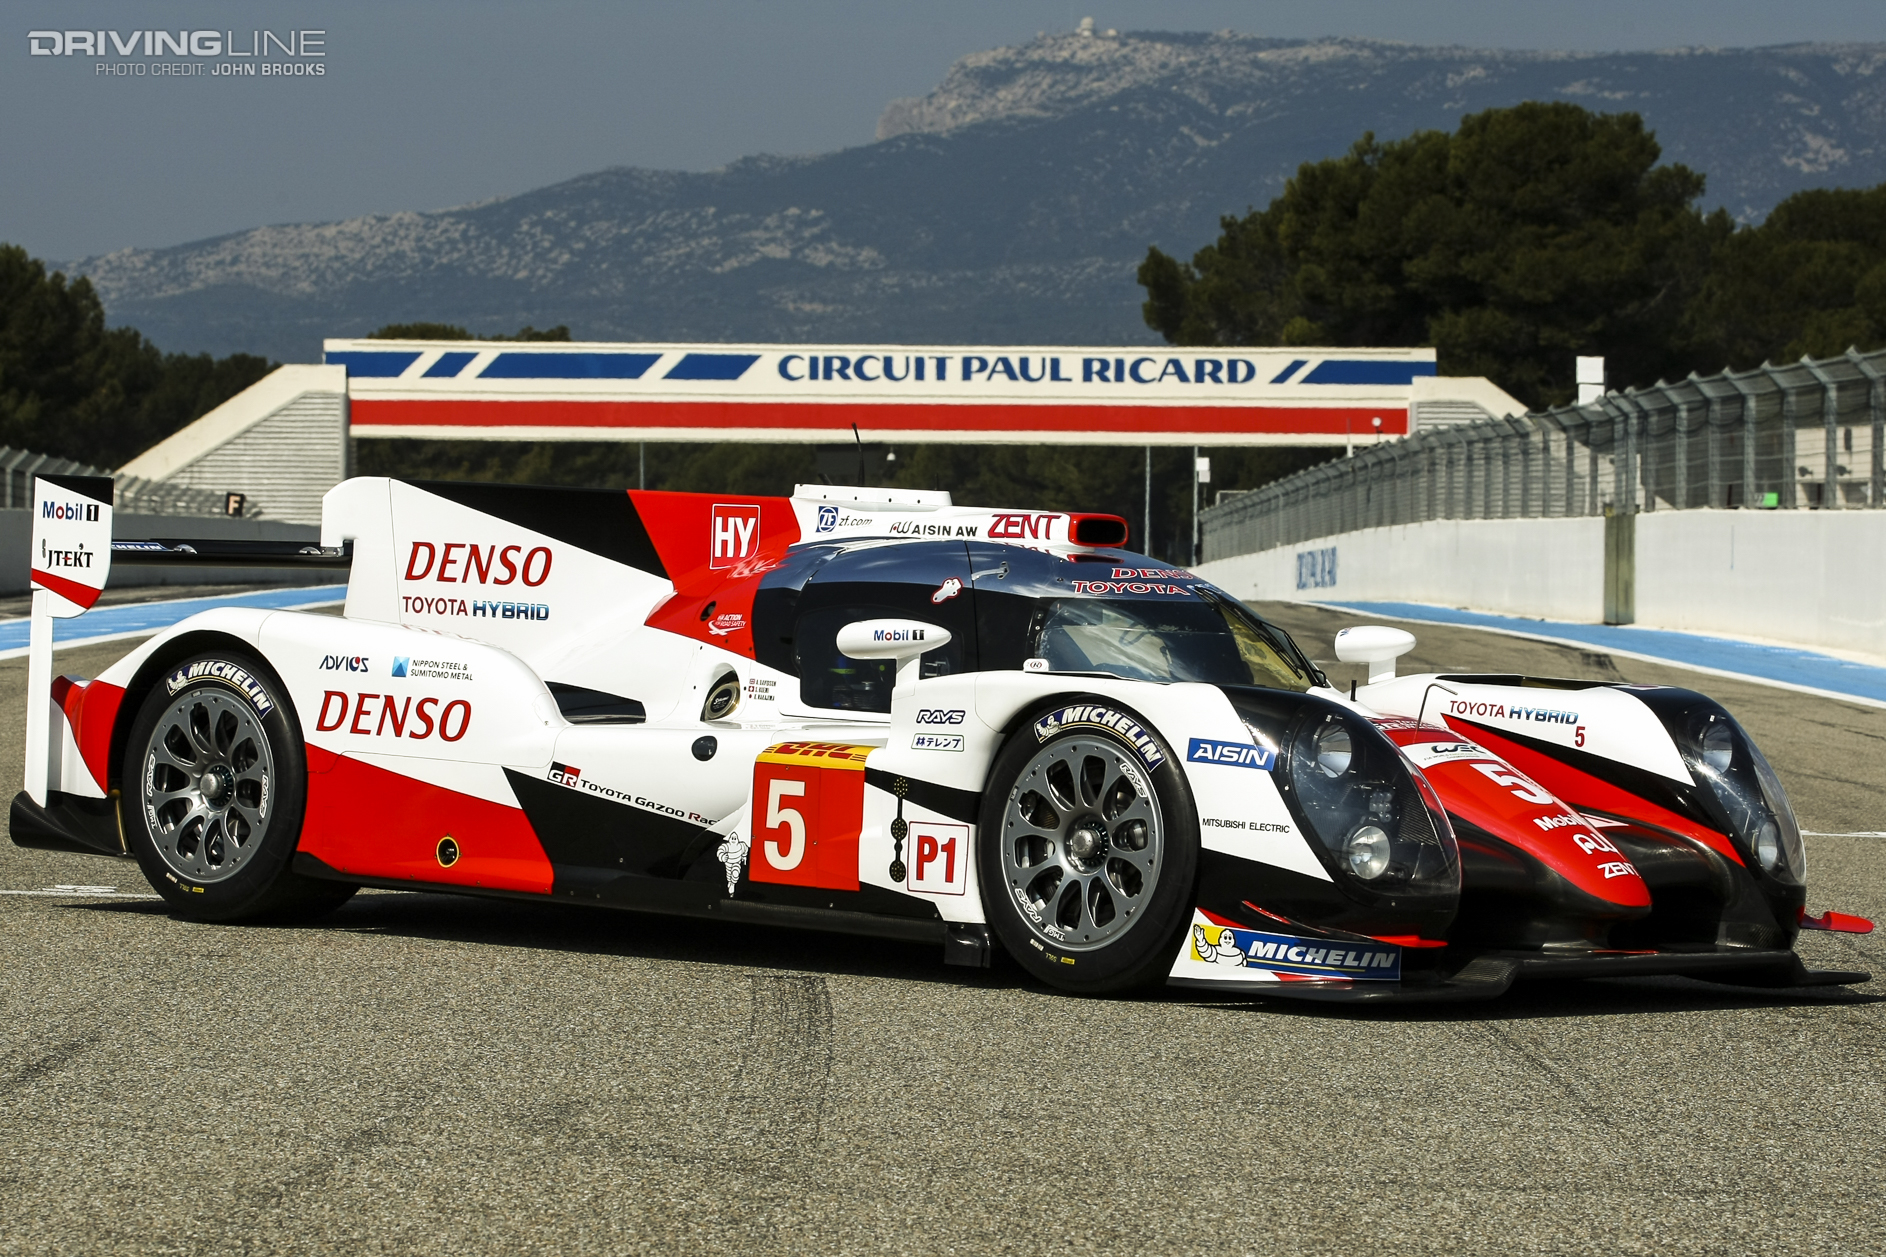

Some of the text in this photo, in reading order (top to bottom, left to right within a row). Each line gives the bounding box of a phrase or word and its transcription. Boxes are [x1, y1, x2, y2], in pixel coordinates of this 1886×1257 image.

[778, 355, 1256, 384] CIRCUIT PAUL RICARD
[42, 501, 99, 522] Mobil 1
[227, 494, 241, 516] F
[839, 515, 873, 527] zf.com
[911, 525, 951, 536] AISIN
[956, 526, 978, 537] AW
[988, 513, 1062, 539] ZENT
[714, 516, 757, 558] HY
[46, 550, 94, 569] JTEKT
[404, 541, 553, 587] DENSO
[1072, 581, 1191, 596] TOYOTA
[402, 596, 550, 621] TOYOTA HYBRID
[874, 630, 909, 641] Mobil
[410, 668, 473, 681] SUMITOMO METAL
[412, 660, 468, 671] NIPPON STEEL &
[188, 661, 271, 711] MICHELIN
[316, 690, 472, 742] DENSO
[916, 709, 966, 724] RAYS
[1450, 700, 1579, 725] TOYOTA HYBRID
[916, 736, 962, 749] 林テレンプ
[1061, 706, 1162, 763] MICHELIN
[1574, 726, 1586, 748] 5
[774, 741, 854, 760] DHL
[1193, 743, 1270, 766] AISIN
[1469, 763, 1554, 805] 5
[549, 769, 720, 826] GR TOYOTA GAZOO Rac
[763, 778, 806, 871] 5
[1202, 818, 1290, 834] MITSUBISHI ELECTRIC
[916, 835, 956, 883] P1
[1248, 940, 1396, 968] MICHELIN
